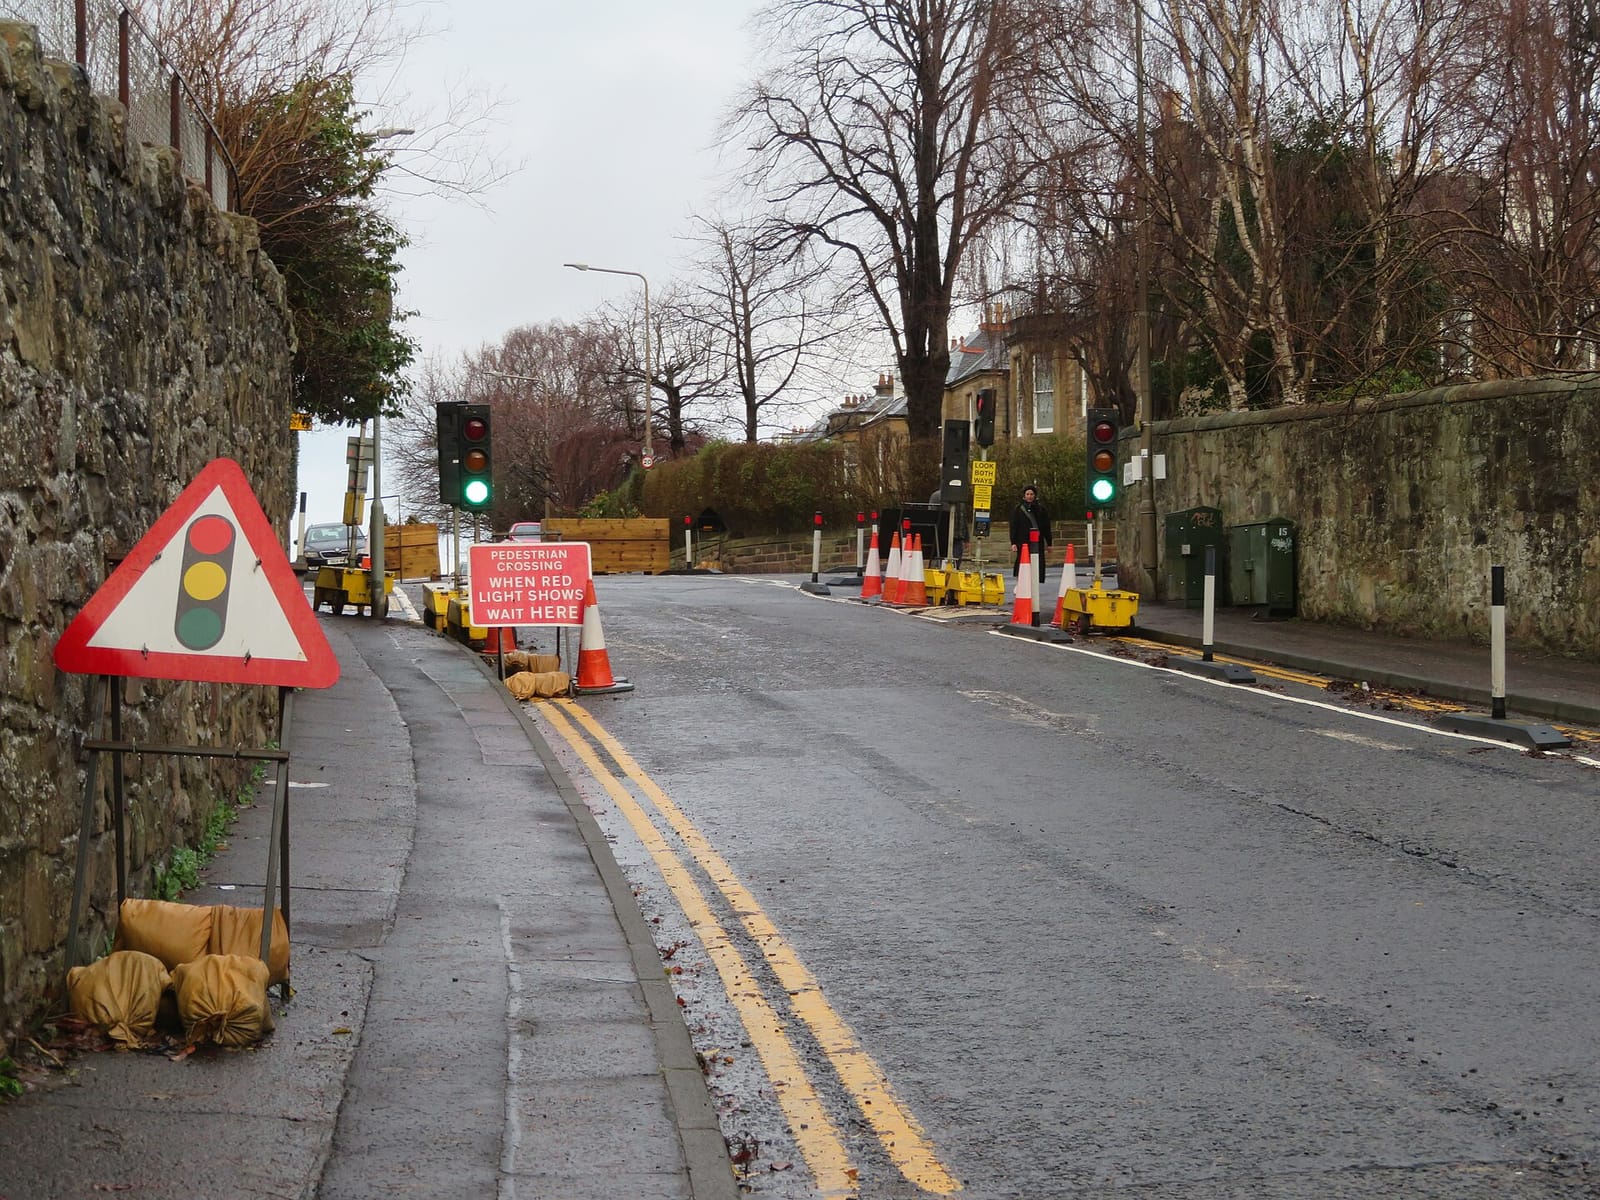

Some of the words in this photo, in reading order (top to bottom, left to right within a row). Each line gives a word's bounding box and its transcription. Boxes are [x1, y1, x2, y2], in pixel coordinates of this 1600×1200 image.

[491, 550, 568, 560] PEDESTRIAN
[497, 561, 563, 572] CROSSING
[489, 576, 536, 588] WHEN
[542, 575, 572, 587] RED
[479, 590, 523, 602] LIGHT
[528, 588, 584, 601] SHOWS
[487, 608, 524, 620] WAIT
[530, 606, 578, 620] HERE
